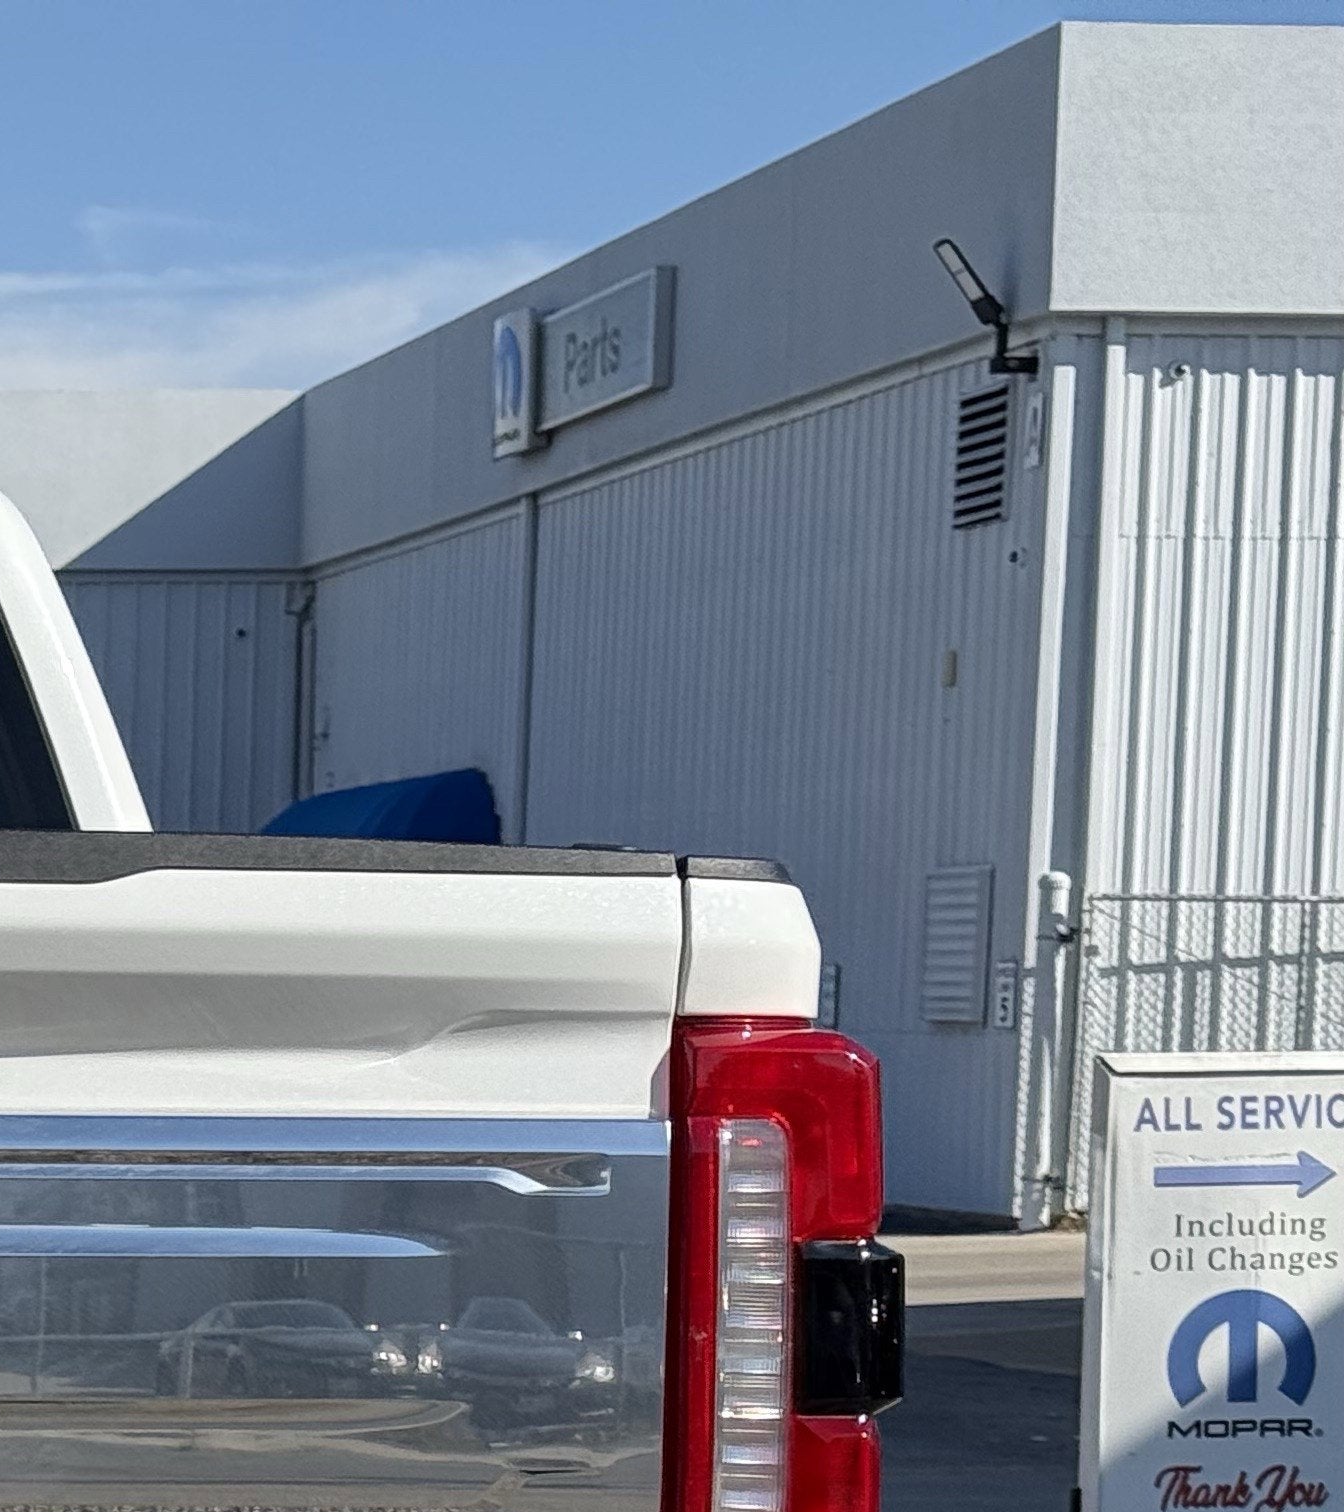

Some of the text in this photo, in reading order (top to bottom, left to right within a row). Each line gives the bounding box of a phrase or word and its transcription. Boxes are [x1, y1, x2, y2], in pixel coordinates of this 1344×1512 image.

[564, 315, 621, 393] Parts
[1133, 1093, 1344, 1132] ALL SERVIC
[1175, 1212, 1327, 1241] Including
[1150, 1247, 1339, 1276] Oil Changes
[1167, 1418, 1314, 1438] MOPAR
[1154, 1465, 1254, 1512] Thank
